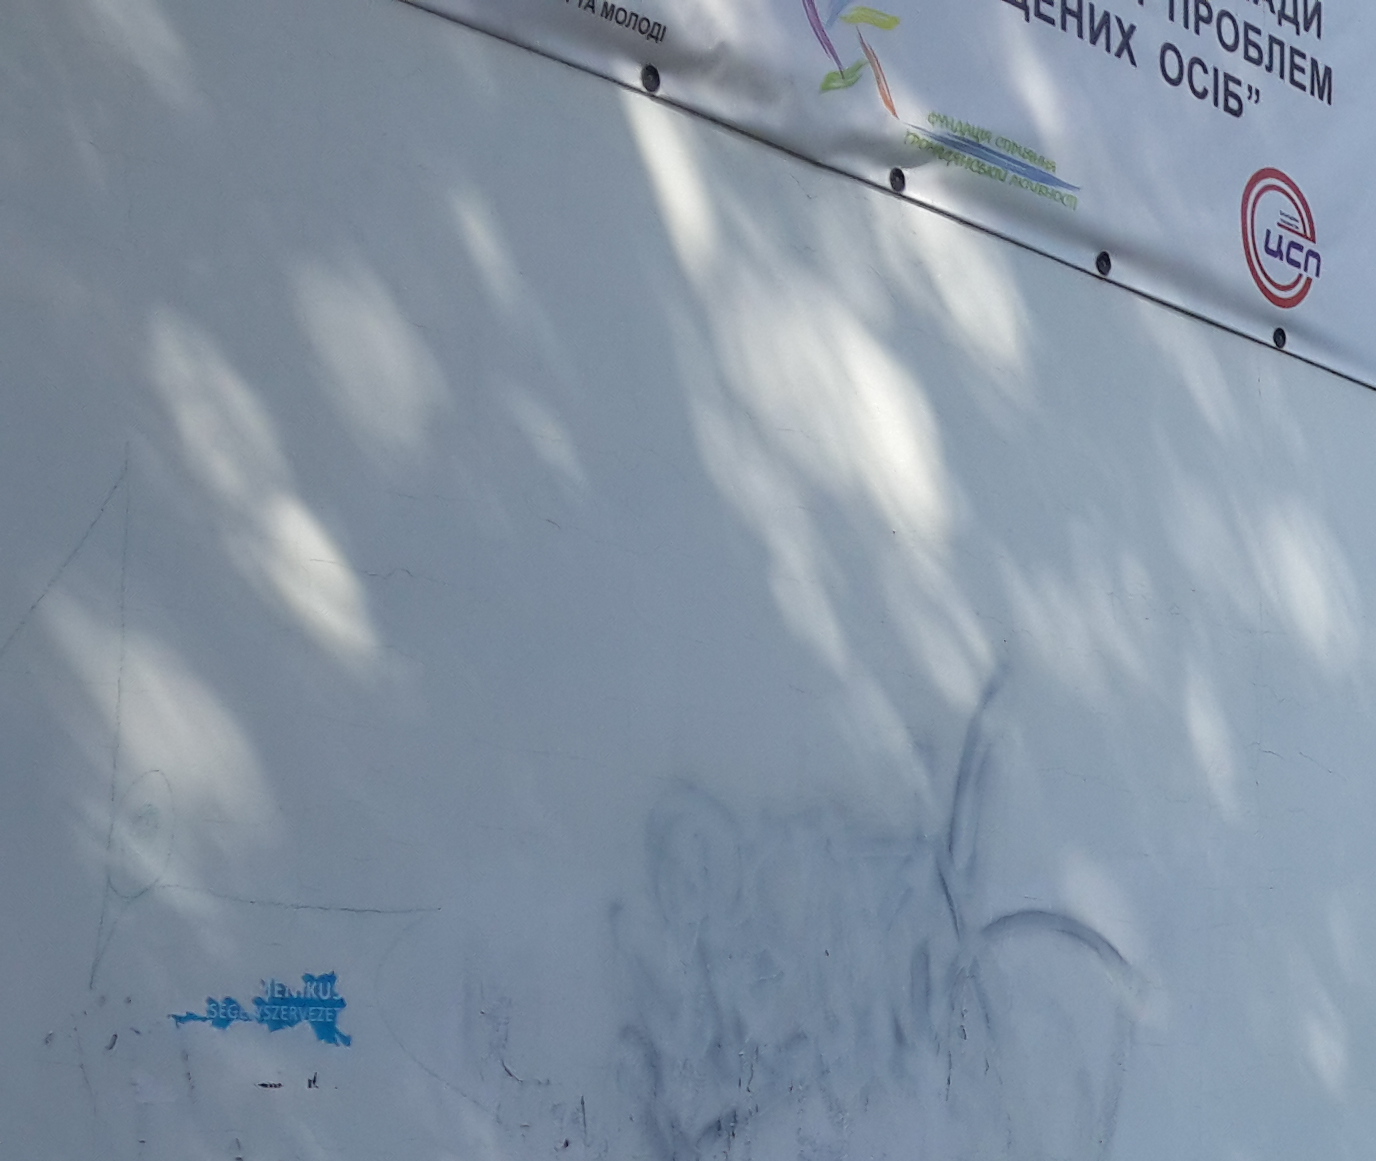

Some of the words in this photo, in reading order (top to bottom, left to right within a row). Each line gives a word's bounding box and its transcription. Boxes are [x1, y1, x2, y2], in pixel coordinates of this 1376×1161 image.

[600, 1, 667, 43] МОЛОДІ
[1001, 0, 1137, 68] ЕНИХ
[1168, 0, 1332, 106] ПРОБЛЕМ
